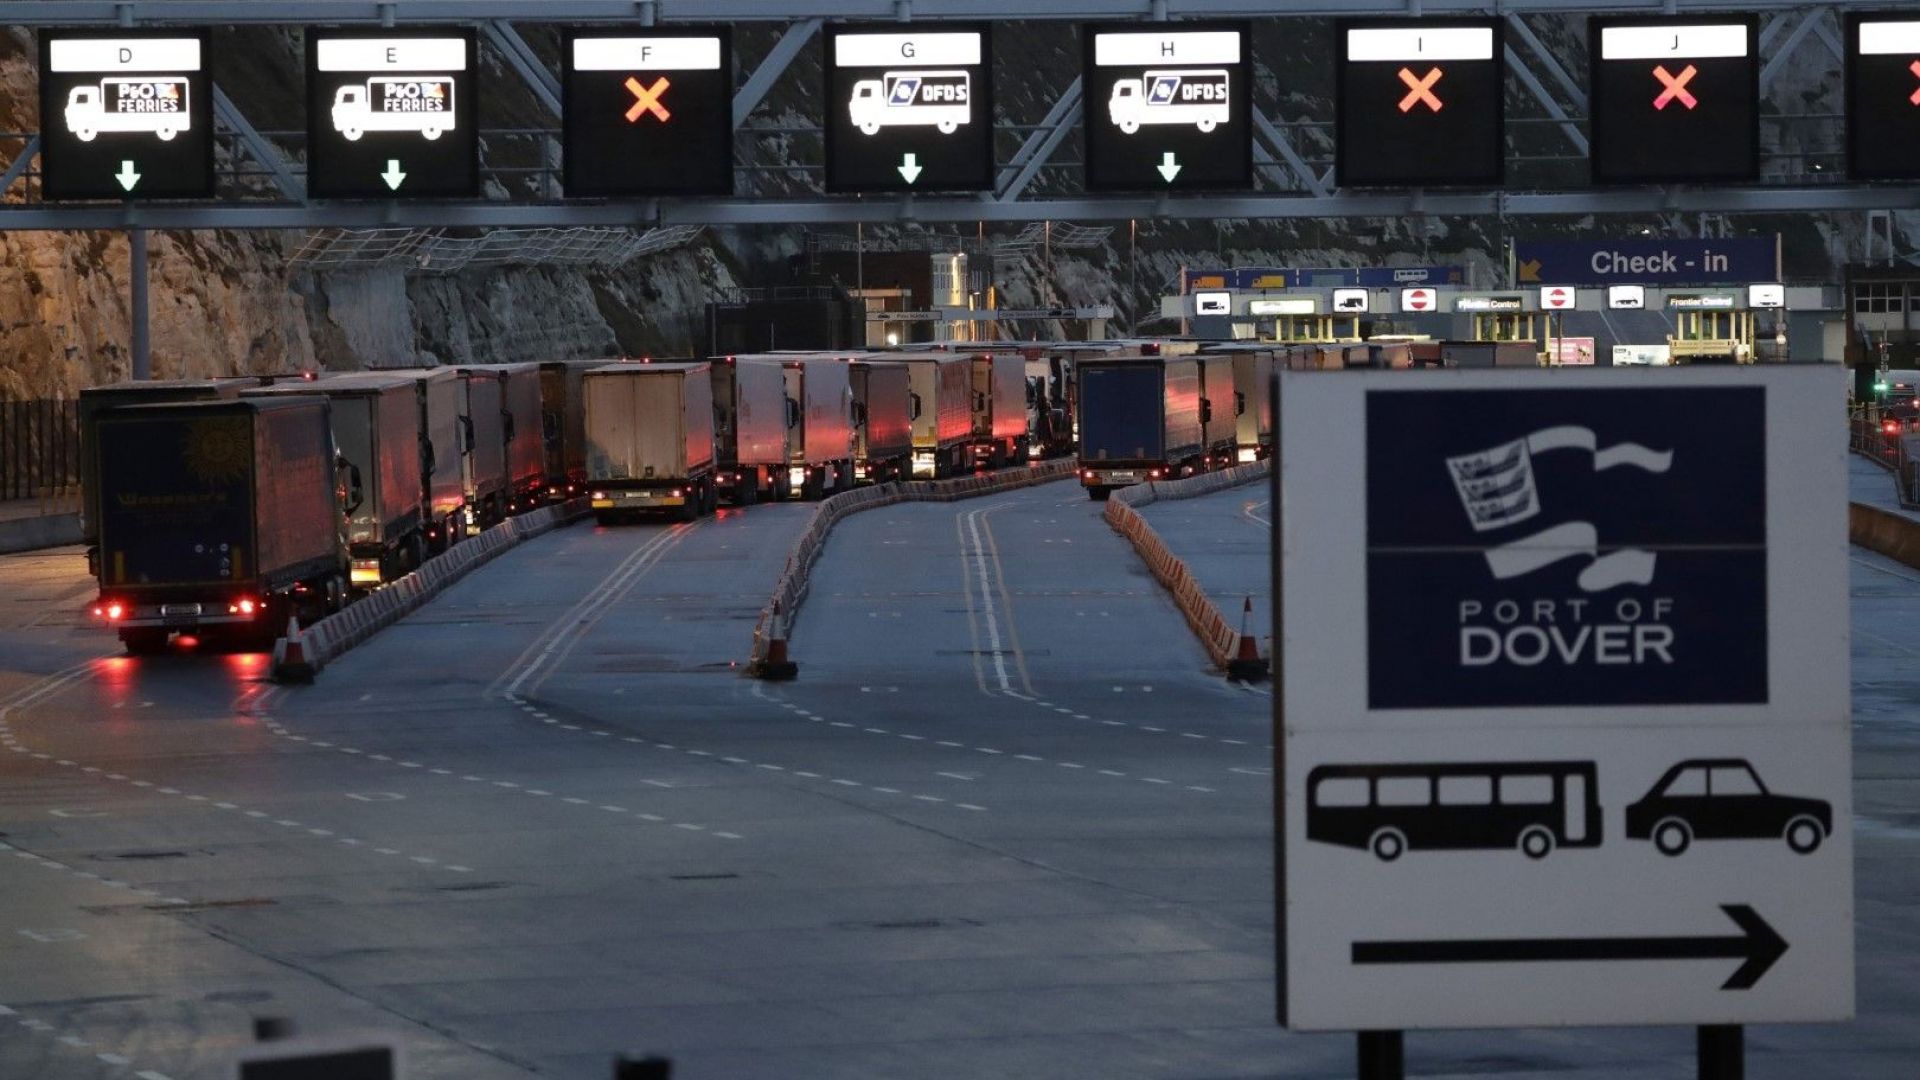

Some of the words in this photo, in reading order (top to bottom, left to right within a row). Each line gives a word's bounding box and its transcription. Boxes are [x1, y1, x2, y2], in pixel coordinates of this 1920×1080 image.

[901, 42, 916, 58] G
[1161, 41, 1175, 57] H
[1670, 34, 1678, 50] J
[119, 47, 133, 64] D
[386, 47, 398, 63] E
[641, 46, 652, 62] F
[922, 84, 967, 102] DFDS
[1182, 83, 1226, 101] DFDS
[117, 99, 179, 113] FERRIES
[383, 98, 444, 112] FERRIES
[1591, 250, 1678, 274] Check
[1704, 250, 1728, 272] in
[1670, 298, 1701, 308] Frontier
[1459, 599, 1588, 623] PORT
[1616, 597, 1674, 622] OF
[1459, 624, 1675, 666] DOVER
